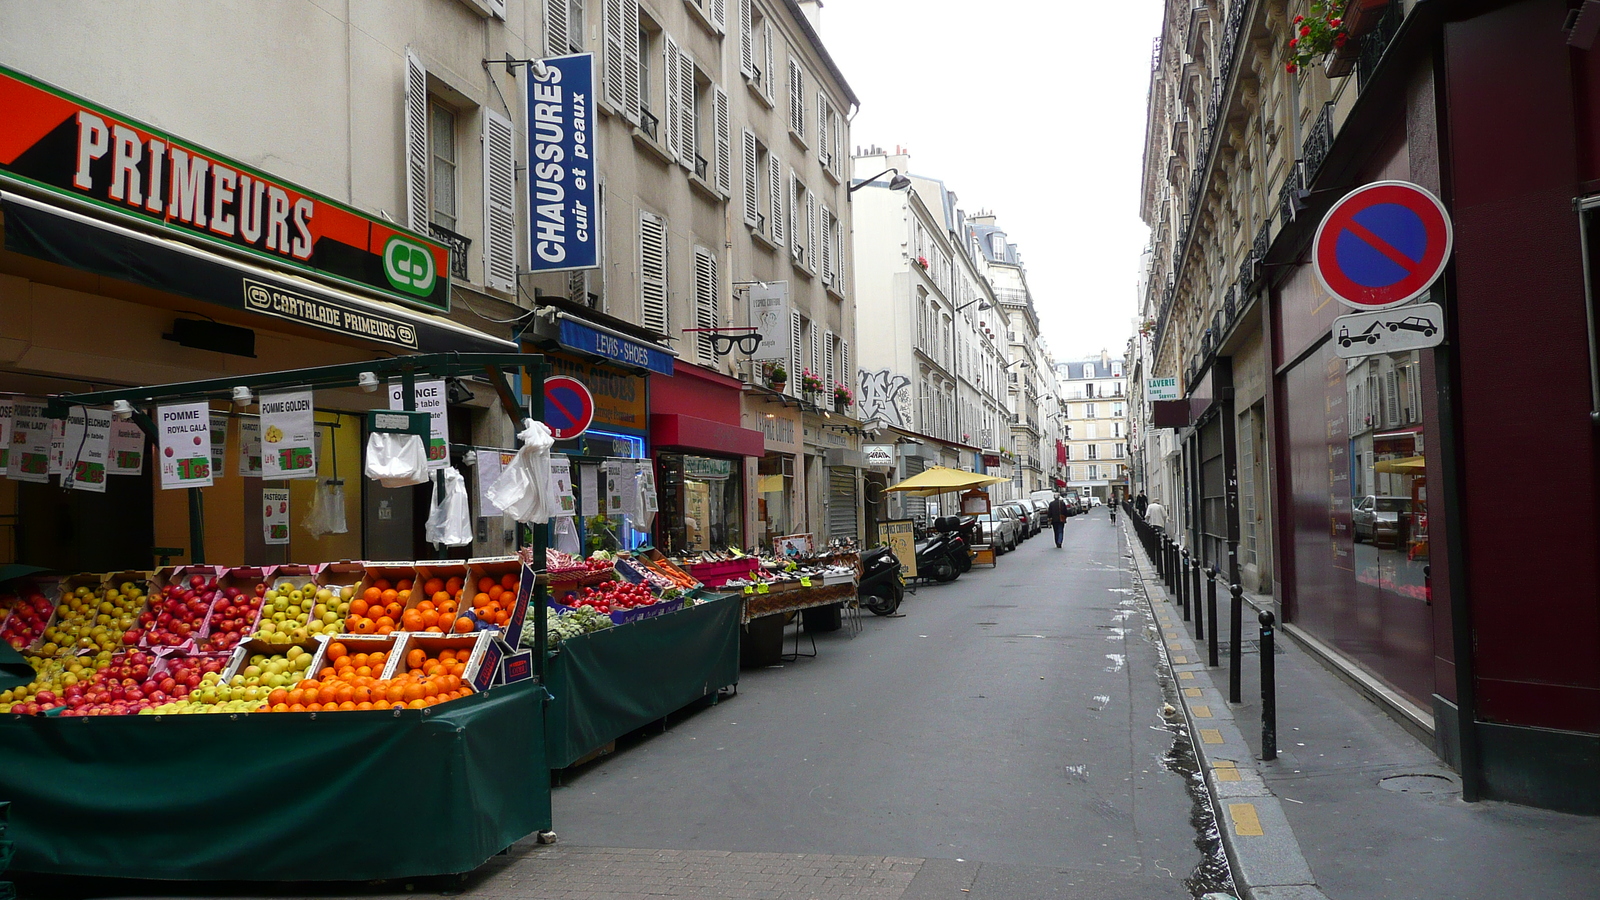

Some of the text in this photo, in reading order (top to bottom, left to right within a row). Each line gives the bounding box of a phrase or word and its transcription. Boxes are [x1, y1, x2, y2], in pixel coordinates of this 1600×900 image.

[533, 65, 566, 263] CHAUSSURES
[572, 92, 588, 242] cuir et peaux
[73, 110, 314, 261] PRIMEURS
[273, 293, 341, 326] CARTALADE
[344, 312, 396, 339] PRIMEURS
[596, 333, 649, 365] LEVIS SHOES
[589, 367, 635, 402] SHOES
[1149, 379, 1175, 387] LAVERIE
[393, 388, 438, 400] ONGE
[262, 400, 310, 414] POMME GOLDEN
[68, 416, 84, 425] POMME
[87, 419, 110, 428] ELCHARD
[164, 410, 199, 421] POMME
[16, 421, 47, 430] PINK LADY
[168, 424, 207, 434] ROYAL GALA
